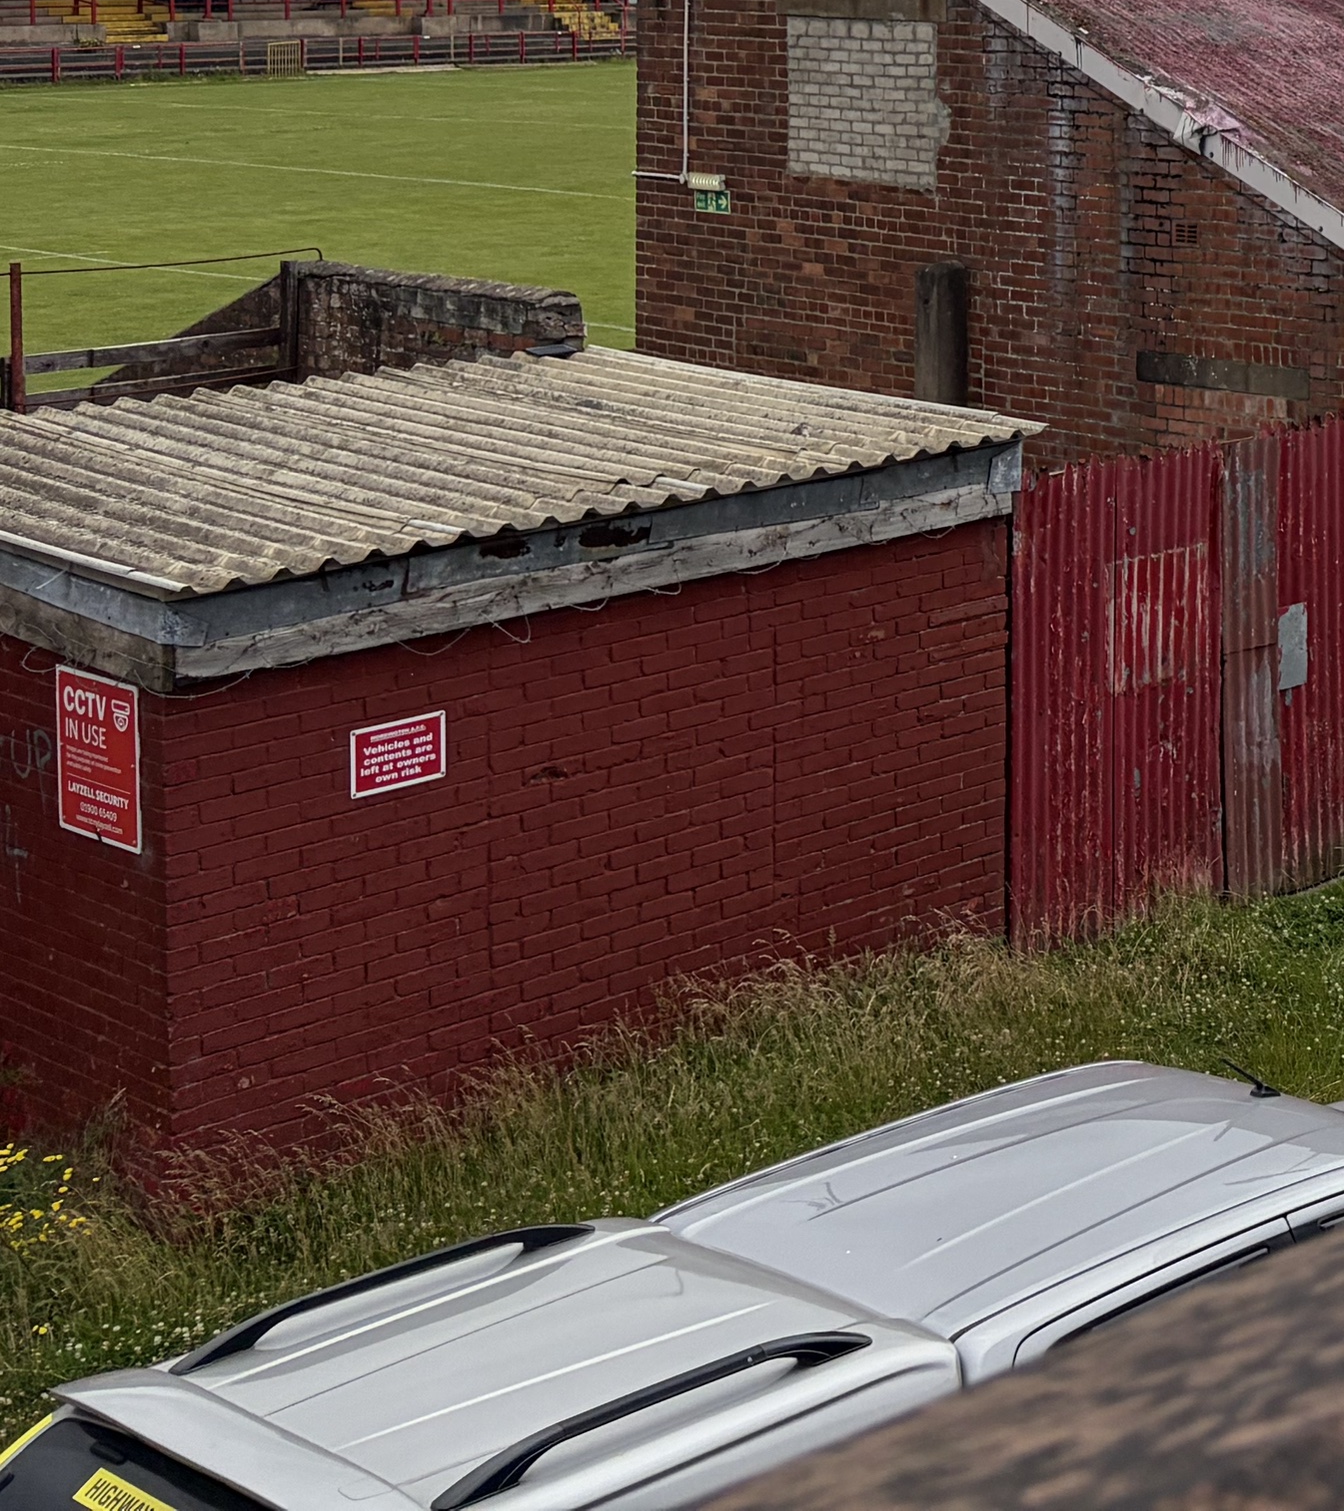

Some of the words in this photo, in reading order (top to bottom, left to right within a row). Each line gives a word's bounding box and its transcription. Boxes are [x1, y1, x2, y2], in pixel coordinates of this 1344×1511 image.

[63, 685, 107, 721] CCTV
[65, 717, 79, 740] IN
[82, 722, 107, 749] USE
[363, 739, 410, 756] Vehicles
[413, 732, 433, 745] and
[360, 765, 379, 777] left
[382, 762, 394, 772] at
[396, 753, 437, 768] owners
[363, 749, 412, 766] contents
[415, 744, 433, 754] are
[375, 772, 398, 783] own
[401, 765, 422, 777] risk
[68, 780, 96, 799] LAYZELL
[95, 790, 129, 810] SECURITY
